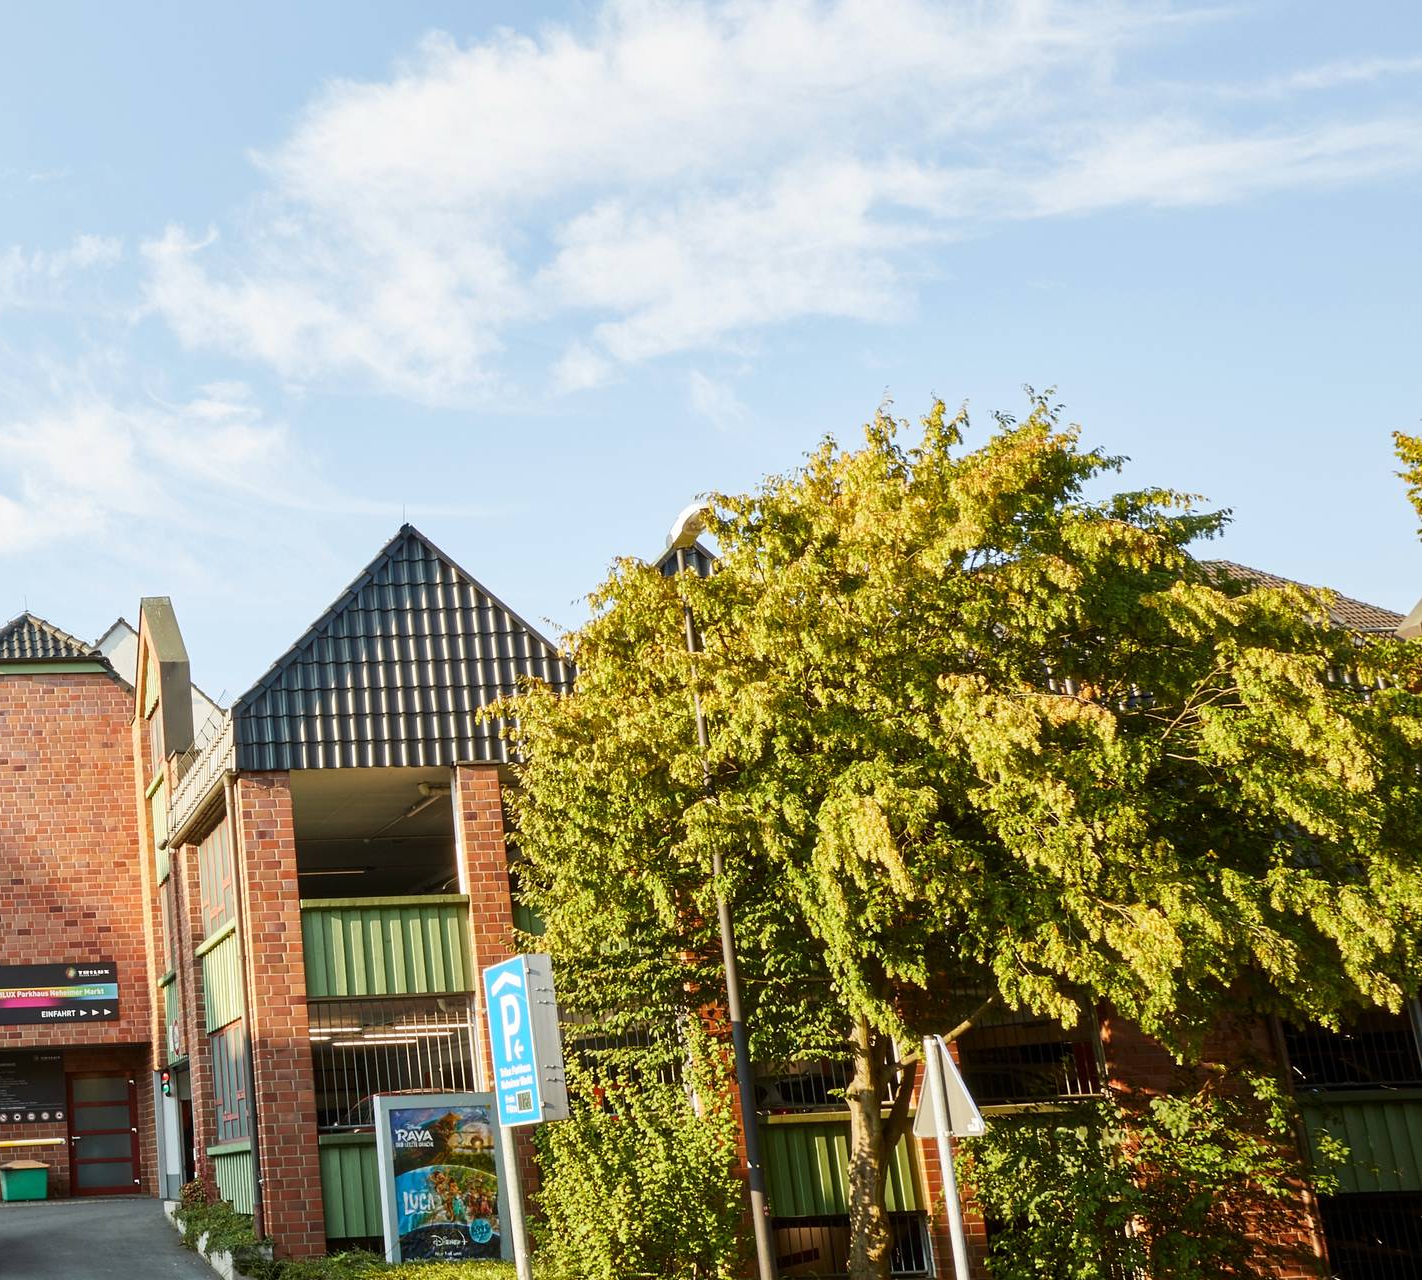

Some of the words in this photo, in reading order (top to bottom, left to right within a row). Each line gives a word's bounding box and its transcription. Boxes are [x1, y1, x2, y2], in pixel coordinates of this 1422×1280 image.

[17, 989, 48, 998] Parkhaus
[50, 989, 82, 997] Neheimer
[84, 988, 104, 996] Markt
[41, 1010, 76, 1018] EINFAHRT
[500, 994, 520, 1062] P
[403, 1191, 435, 1216] LUCA
